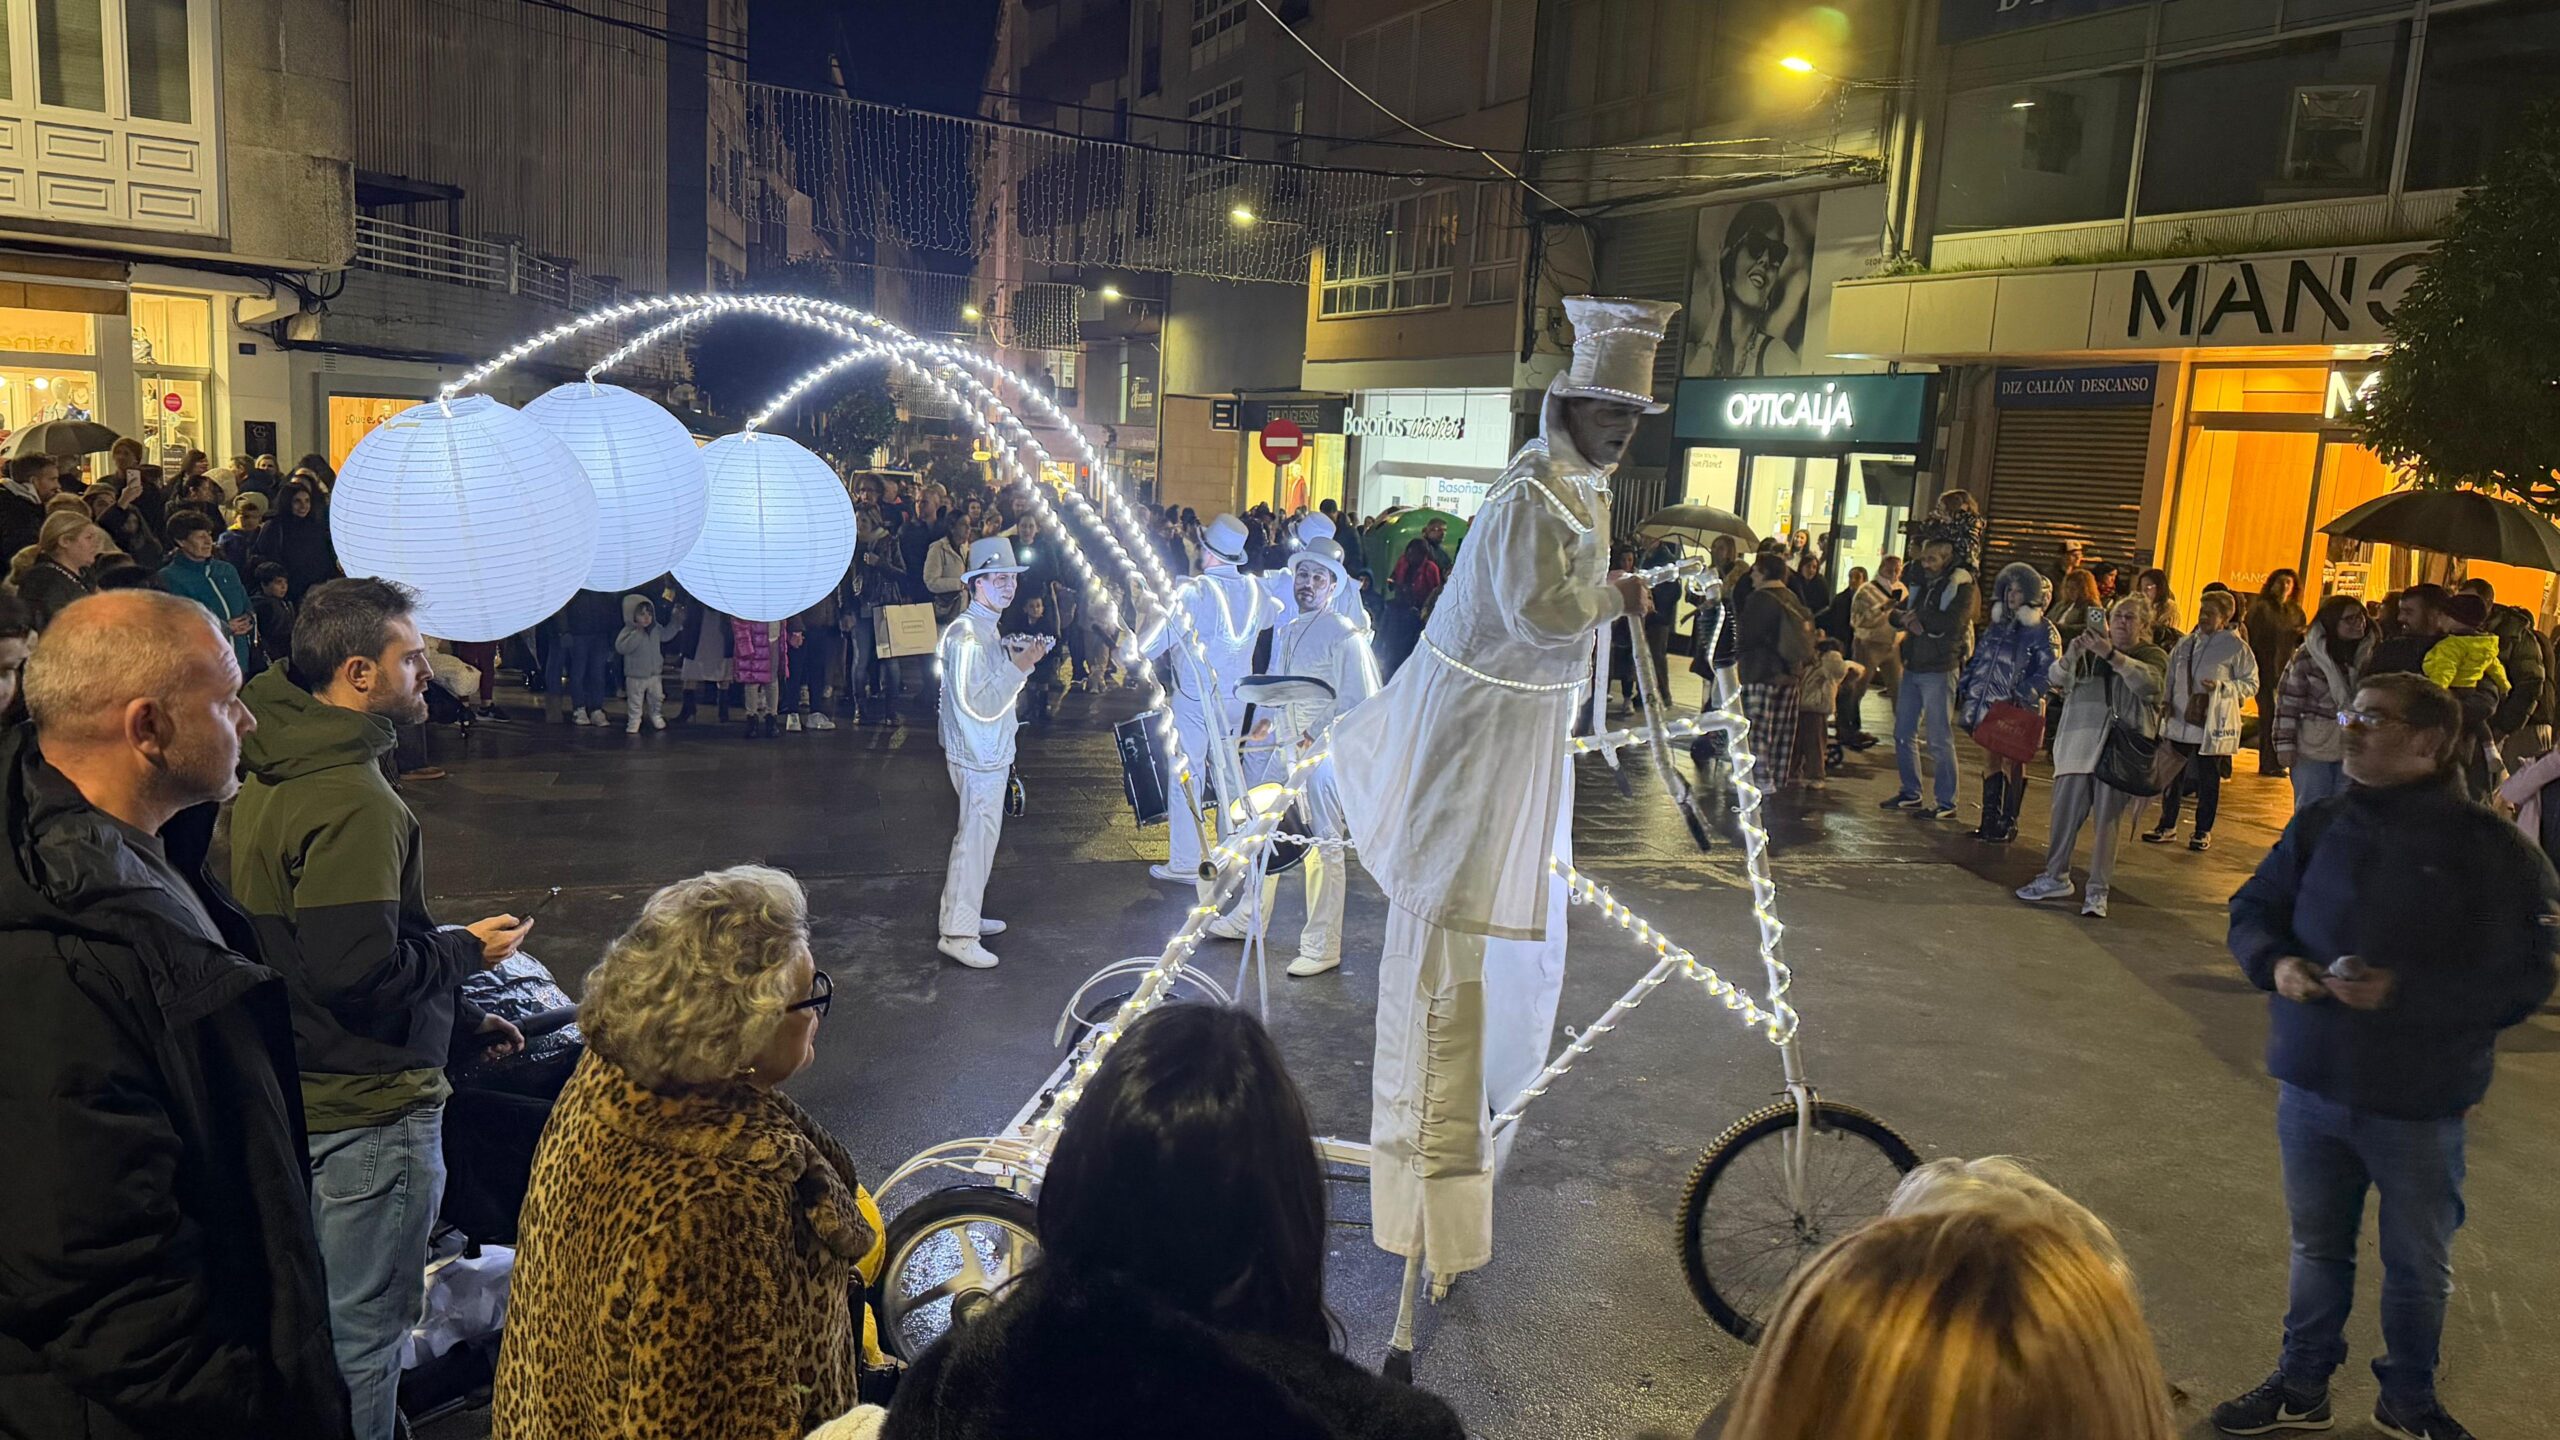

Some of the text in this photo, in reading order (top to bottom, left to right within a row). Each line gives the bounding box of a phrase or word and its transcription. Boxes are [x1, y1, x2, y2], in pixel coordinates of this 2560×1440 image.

[2002, 376, 2149, 394] DIZ CALLÓN DESCANSO
[1343, 407, 1404, 437] Basoñas
[1438, 480, 1483, 495] Basoñas
